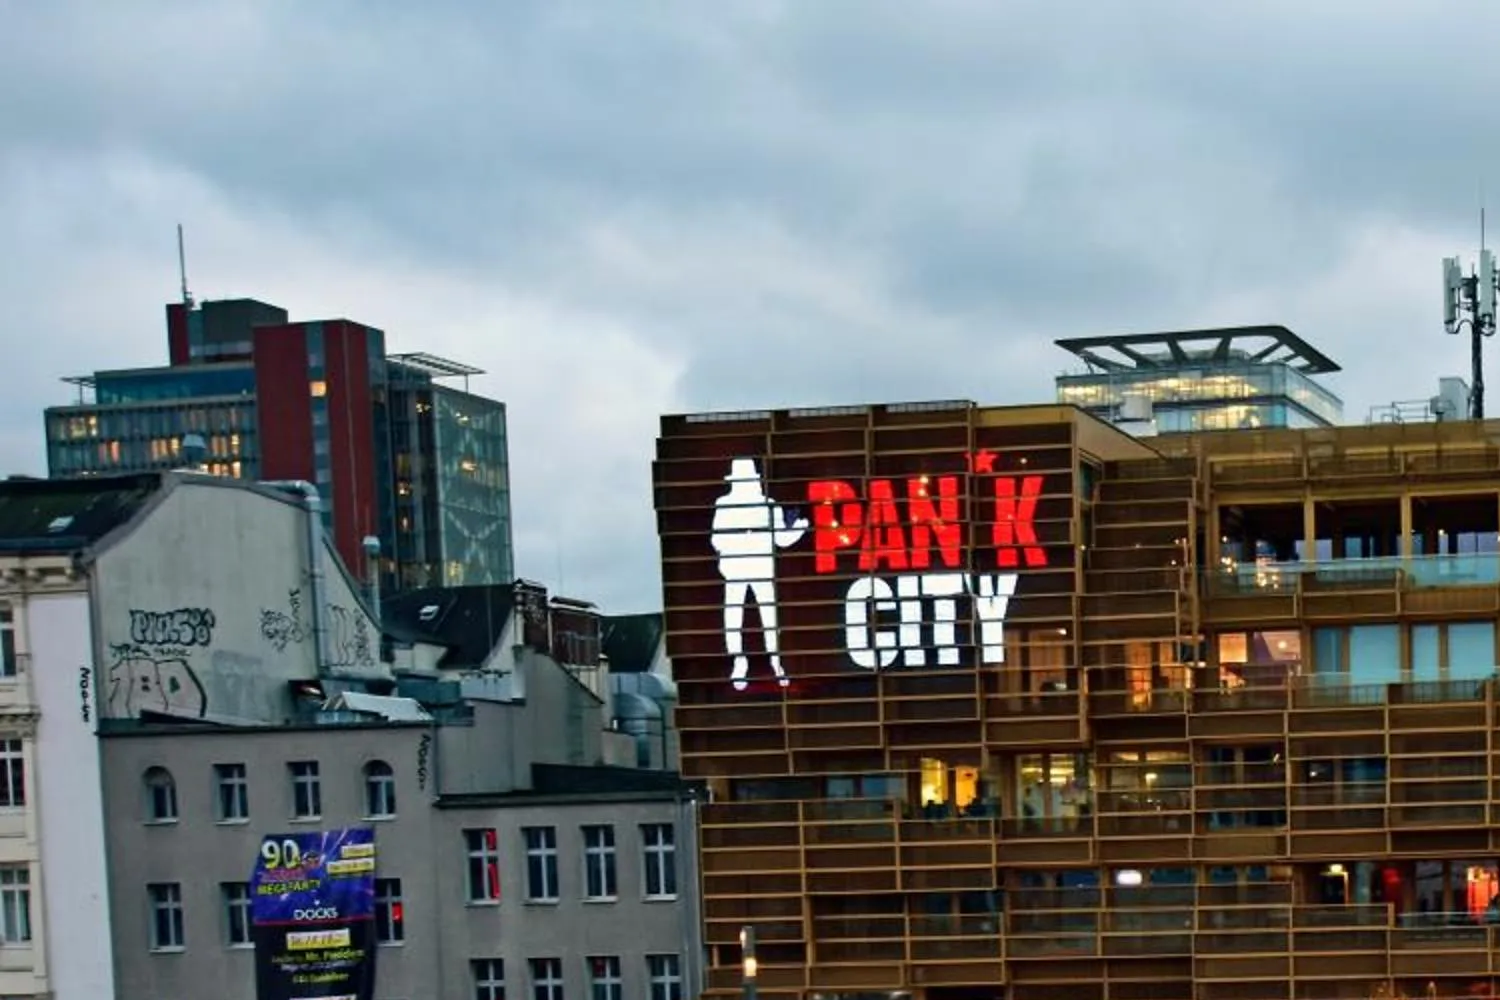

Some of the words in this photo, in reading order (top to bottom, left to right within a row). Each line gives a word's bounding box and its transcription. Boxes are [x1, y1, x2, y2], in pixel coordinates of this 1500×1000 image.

[808, 476, 1048, 574] PANK
[844, 573, 1018, 668] CITY
[294, 907, 338, 920] DOCKS
